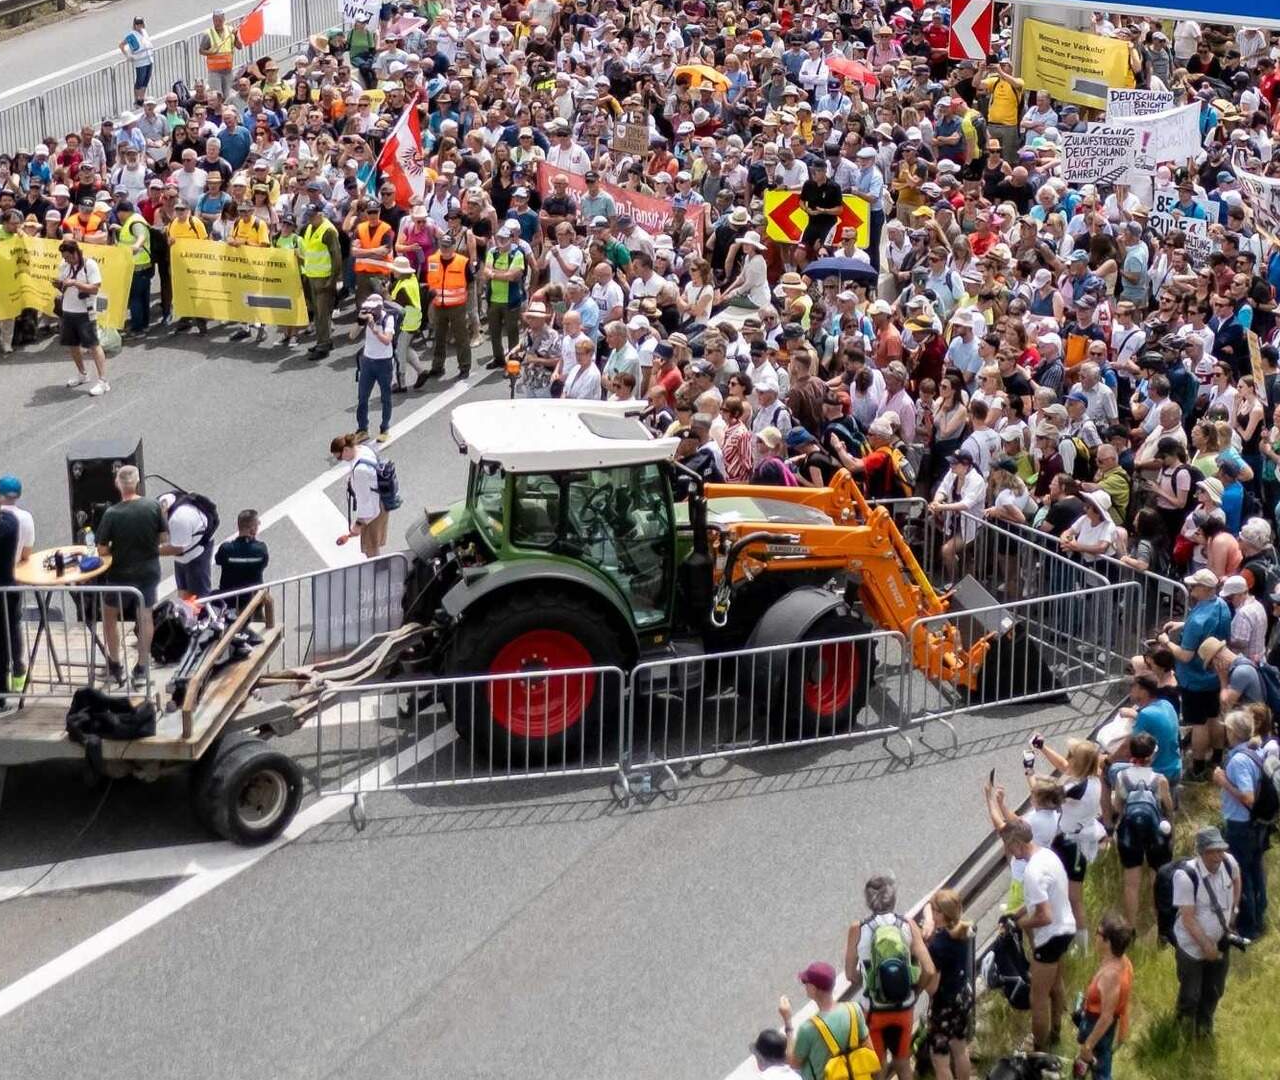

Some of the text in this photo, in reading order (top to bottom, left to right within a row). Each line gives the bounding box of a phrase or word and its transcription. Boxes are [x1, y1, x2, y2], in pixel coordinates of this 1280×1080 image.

[1111, 90, 1173, 102] DEUTSCHLAND
[1134, 101, 1165, 110] BRICHT
[1064, 135, 1135, 148] ZULAUFSTRECKEN?
[1065, 147, 1126, 158] DEUTSCHLAND
[1097, 157, 1114, 167] SEIT
[1064, 167, 1104, 181] JAHREN!
